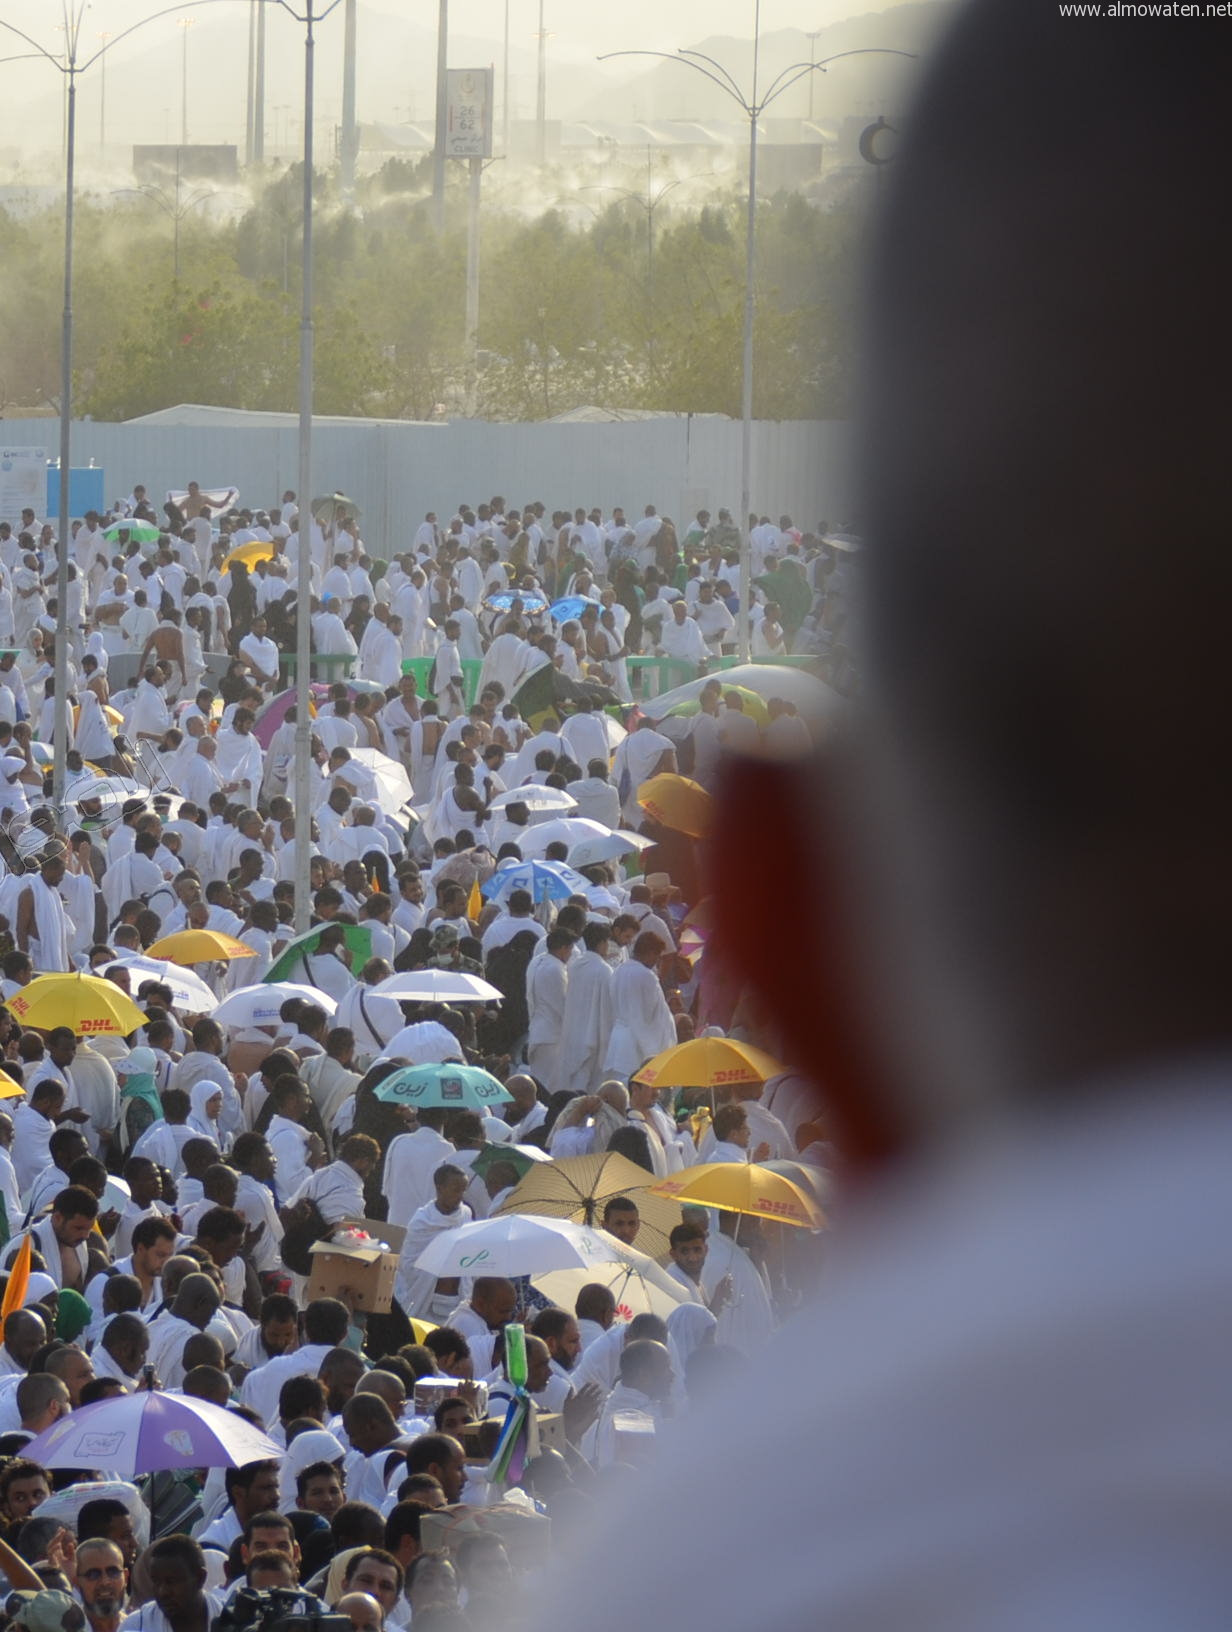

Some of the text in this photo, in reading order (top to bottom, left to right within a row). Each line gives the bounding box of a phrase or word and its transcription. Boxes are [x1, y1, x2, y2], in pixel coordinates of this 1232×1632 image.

[460, 104, 474, 116] 26
[460, 119, 474, 130] 62
[79, 1019, 114, 1032] DHL
[714, 1069, 751, 1082] DHL
[393, 1082, 428, 1098] زين
[758, 1199, 796, 1215] DHL
